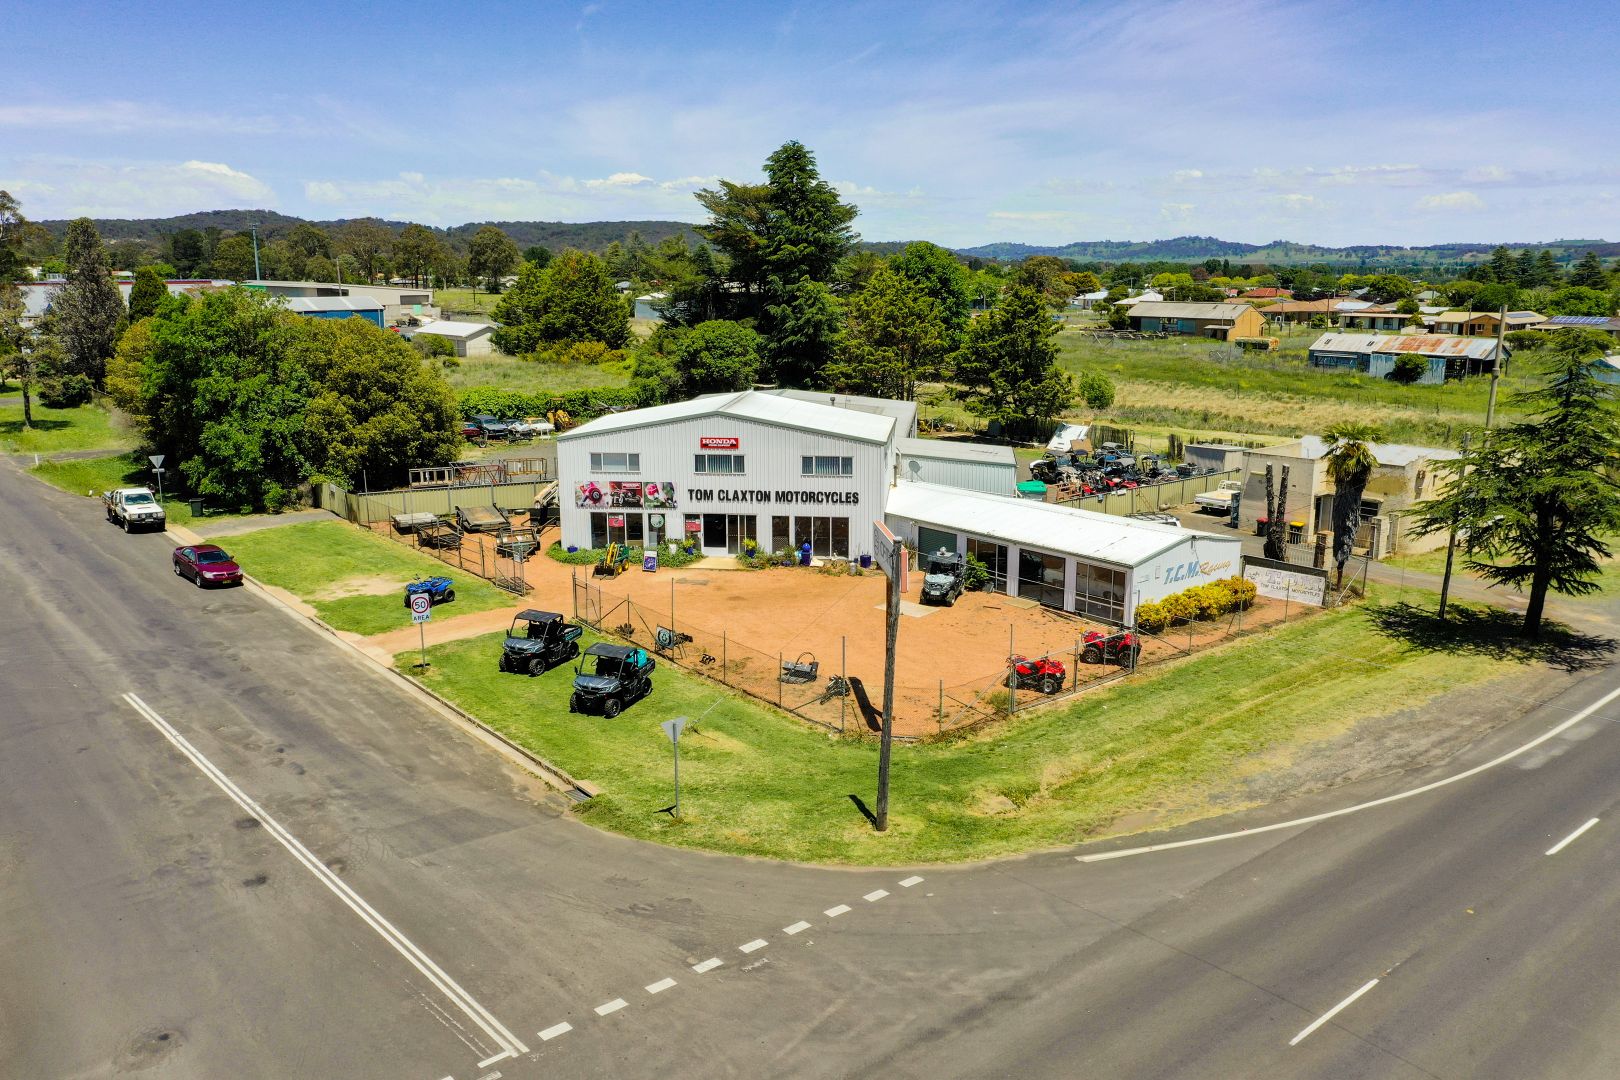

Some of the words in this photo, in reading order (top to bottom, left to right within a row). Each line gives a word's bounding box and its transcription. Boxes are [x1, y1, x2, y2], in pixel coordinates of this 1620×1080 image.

[688, 489, 714, 502] TOM
[718, 489, 771, 503] CLAXTON
[775, 491, 859, 504] MOTORCYCLES
[415, 601, 426, 610] 50
